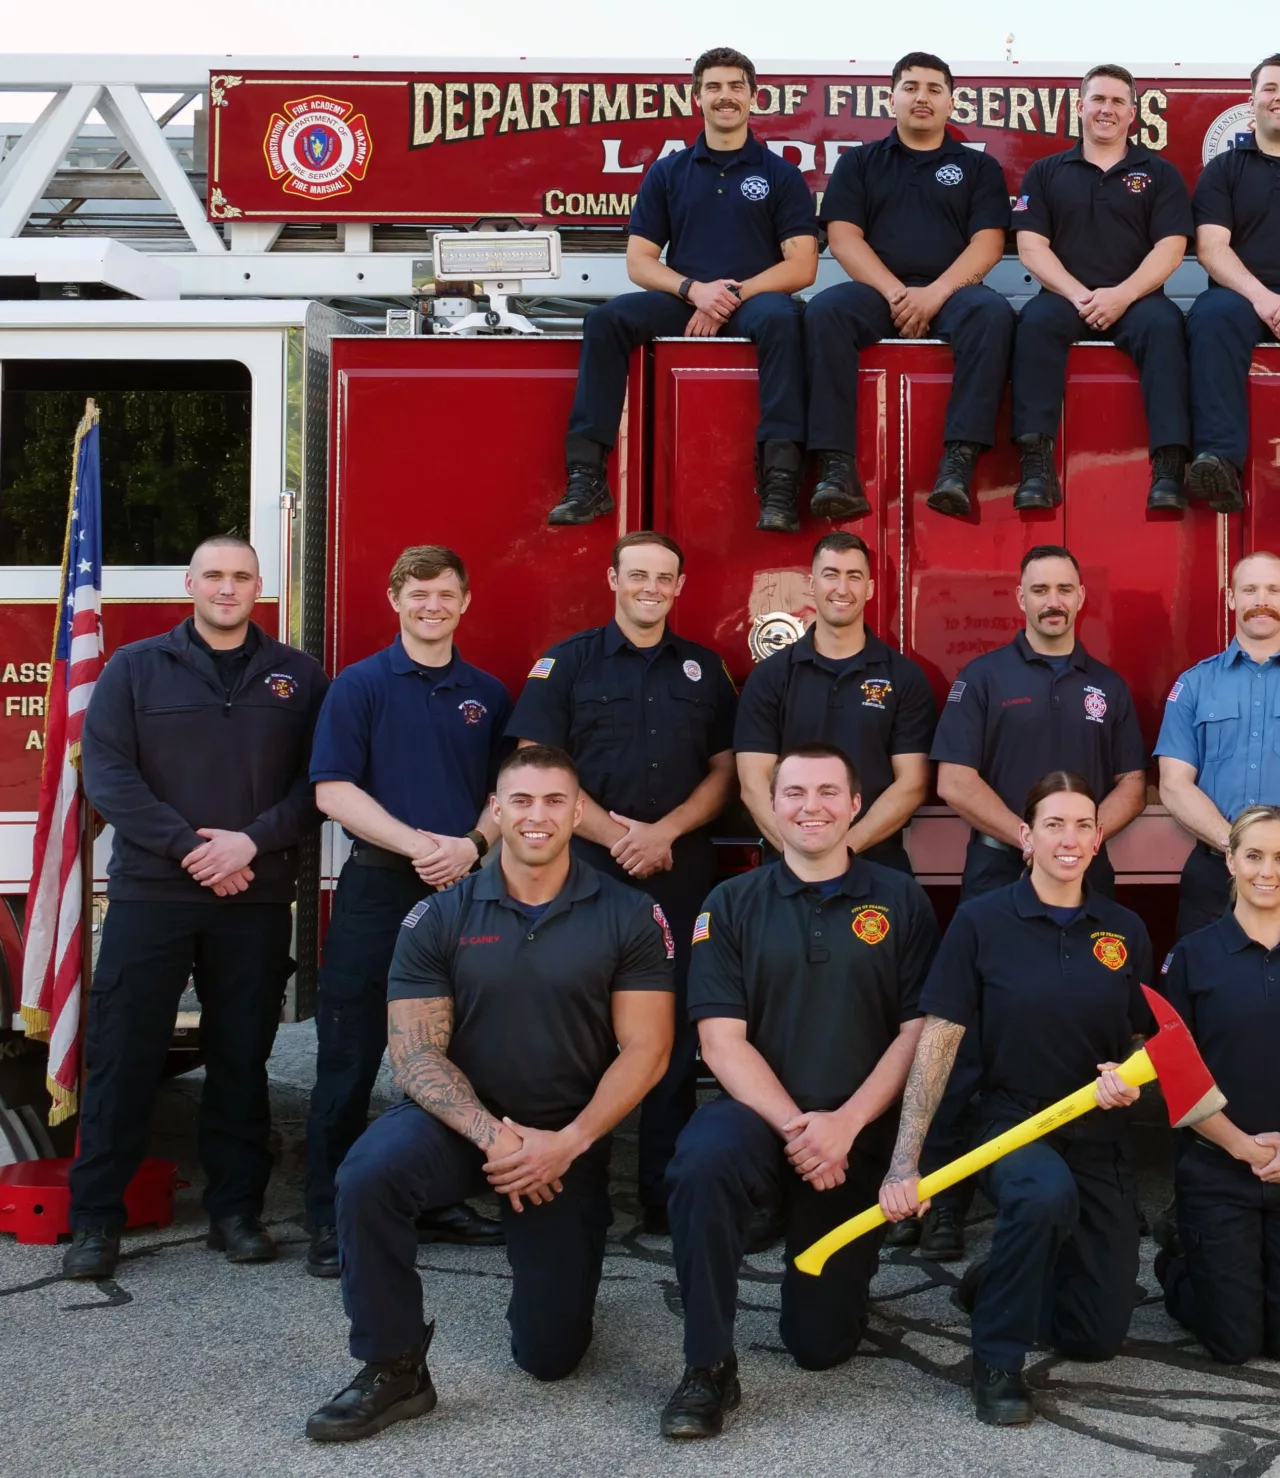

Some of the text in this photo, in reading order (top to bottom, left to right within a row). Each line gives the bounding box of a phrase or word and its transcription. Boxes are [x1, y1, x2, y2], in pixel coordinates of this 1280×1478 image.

[291, 100, 346, 116] FIRE ACADEMY
[413, 82, 1169, 151] DEPARTMEN OF FIR SERVIS
[287, 115, 348, 138] DEPARTMENT OF
[269, 119, 286, 174] ADMINISTRATION
[354, 129, 367, 166] HAZMAT
[290, 162, 345, 180] FIRE SERVICES
[291, 179, 346, 194] FIRE MARSHAL
[5, 696, 48, 716] FIR
